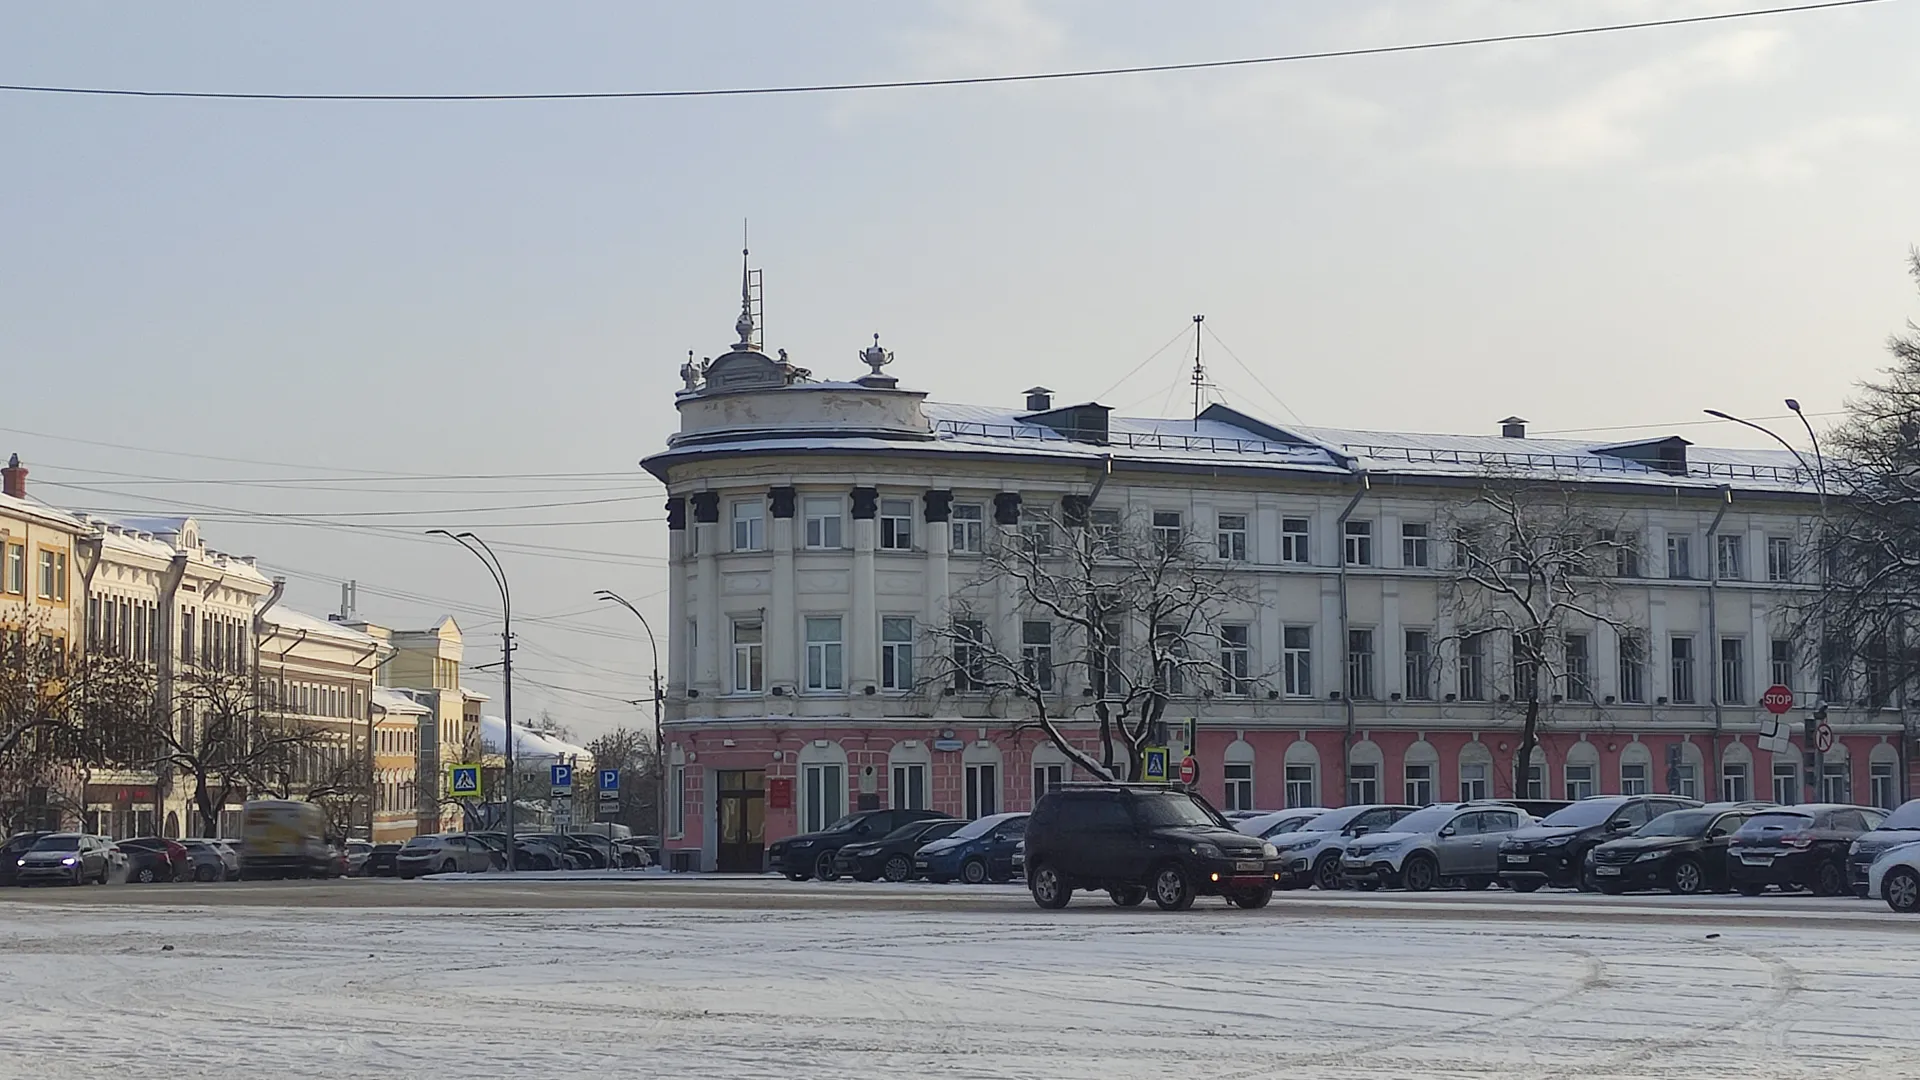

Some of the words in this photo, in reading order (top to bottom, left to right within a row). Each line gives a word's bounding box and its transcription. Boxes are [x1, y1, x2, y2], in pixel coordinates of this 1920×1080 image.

[1765, 694, 1792, 705] STOP
[556, 767, 567, 784] P
[604, 772, 615, 787] P
